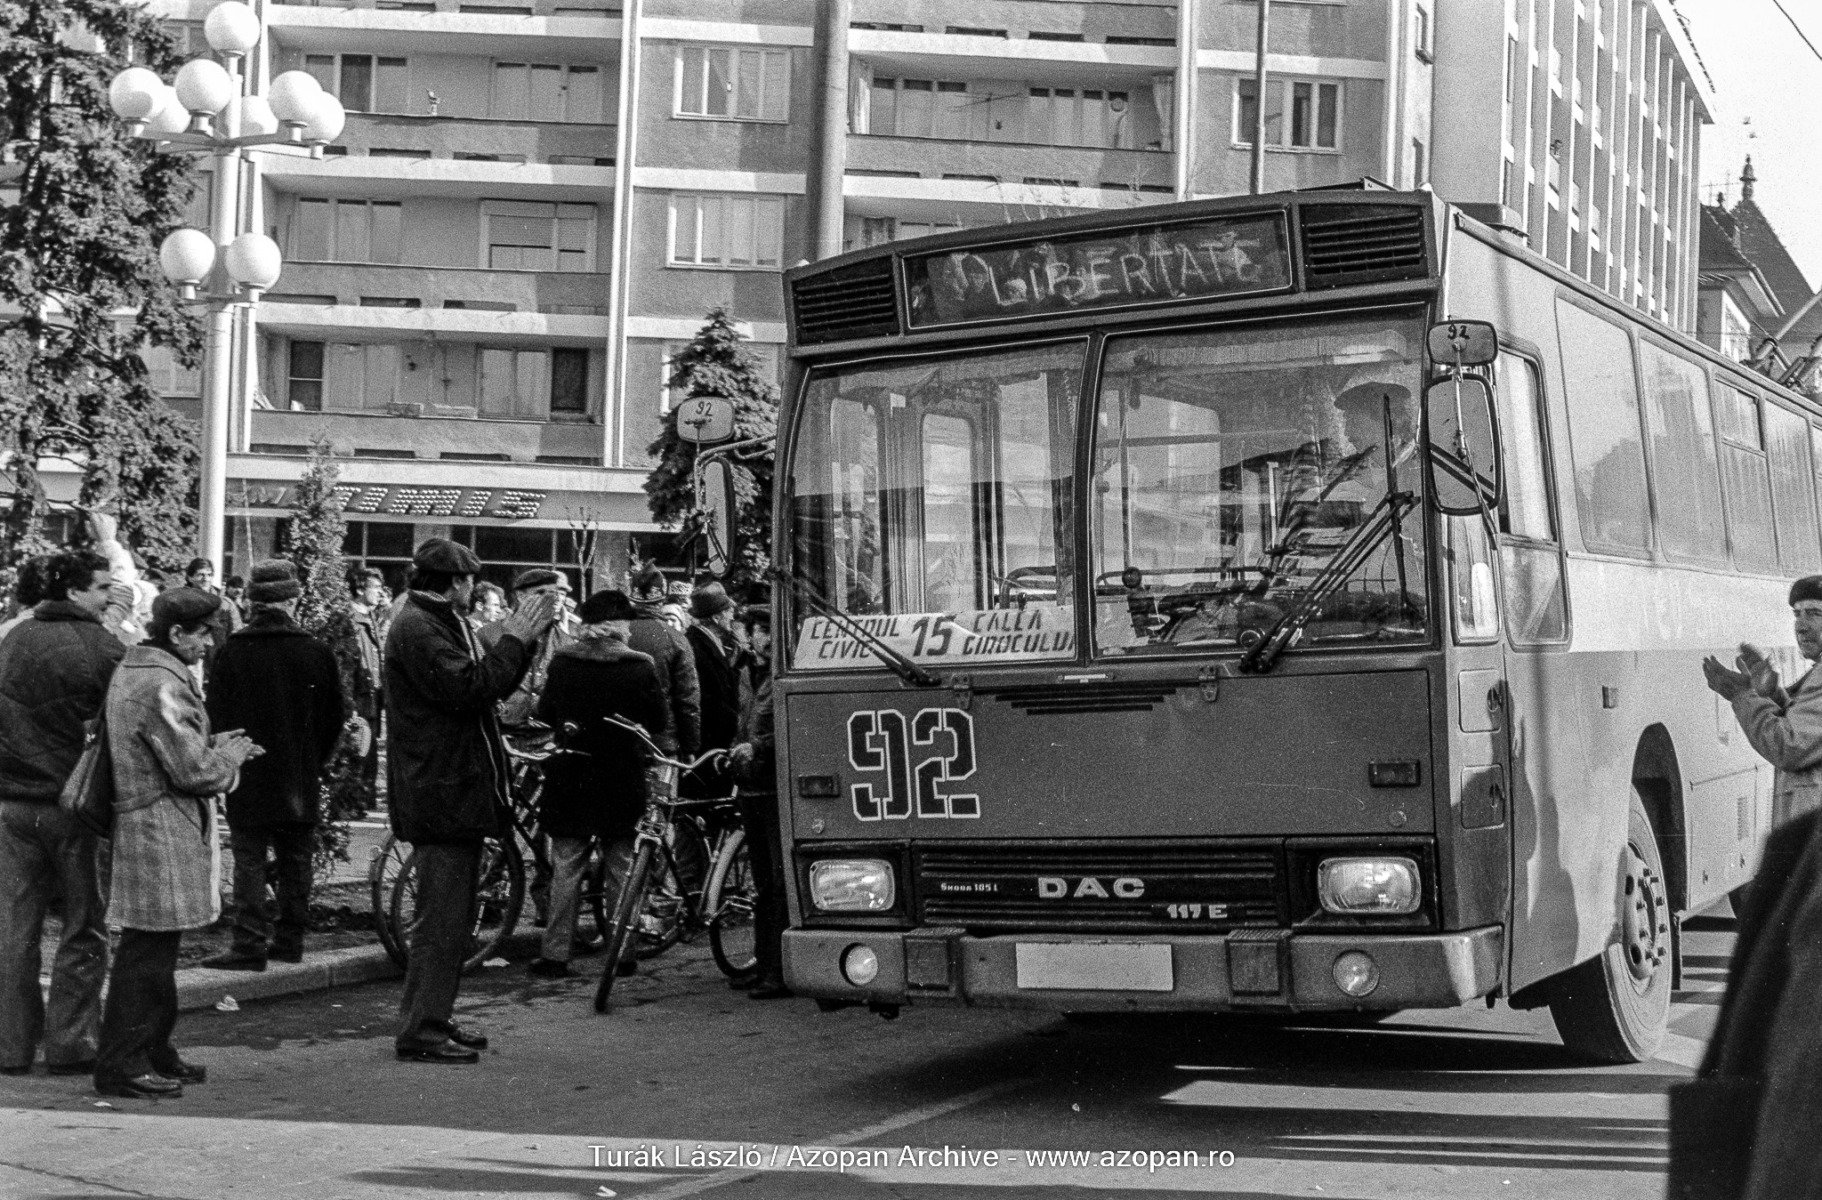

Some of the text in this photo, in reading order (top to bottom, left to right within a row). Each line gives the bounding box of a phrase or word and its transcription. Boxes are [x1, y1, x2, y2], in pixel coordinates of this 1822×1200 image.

[1447, 323, 1470, 340] 92
[695, 401, 713, 417] 92
[911, 614, 957, 657] 15
[819, 639, 876, 659] CIVIC
[847, 708, 981, 821] 92
[1038, 877, 1145, 898] DAC
[1166, 904, 1228, 919] 117 E
